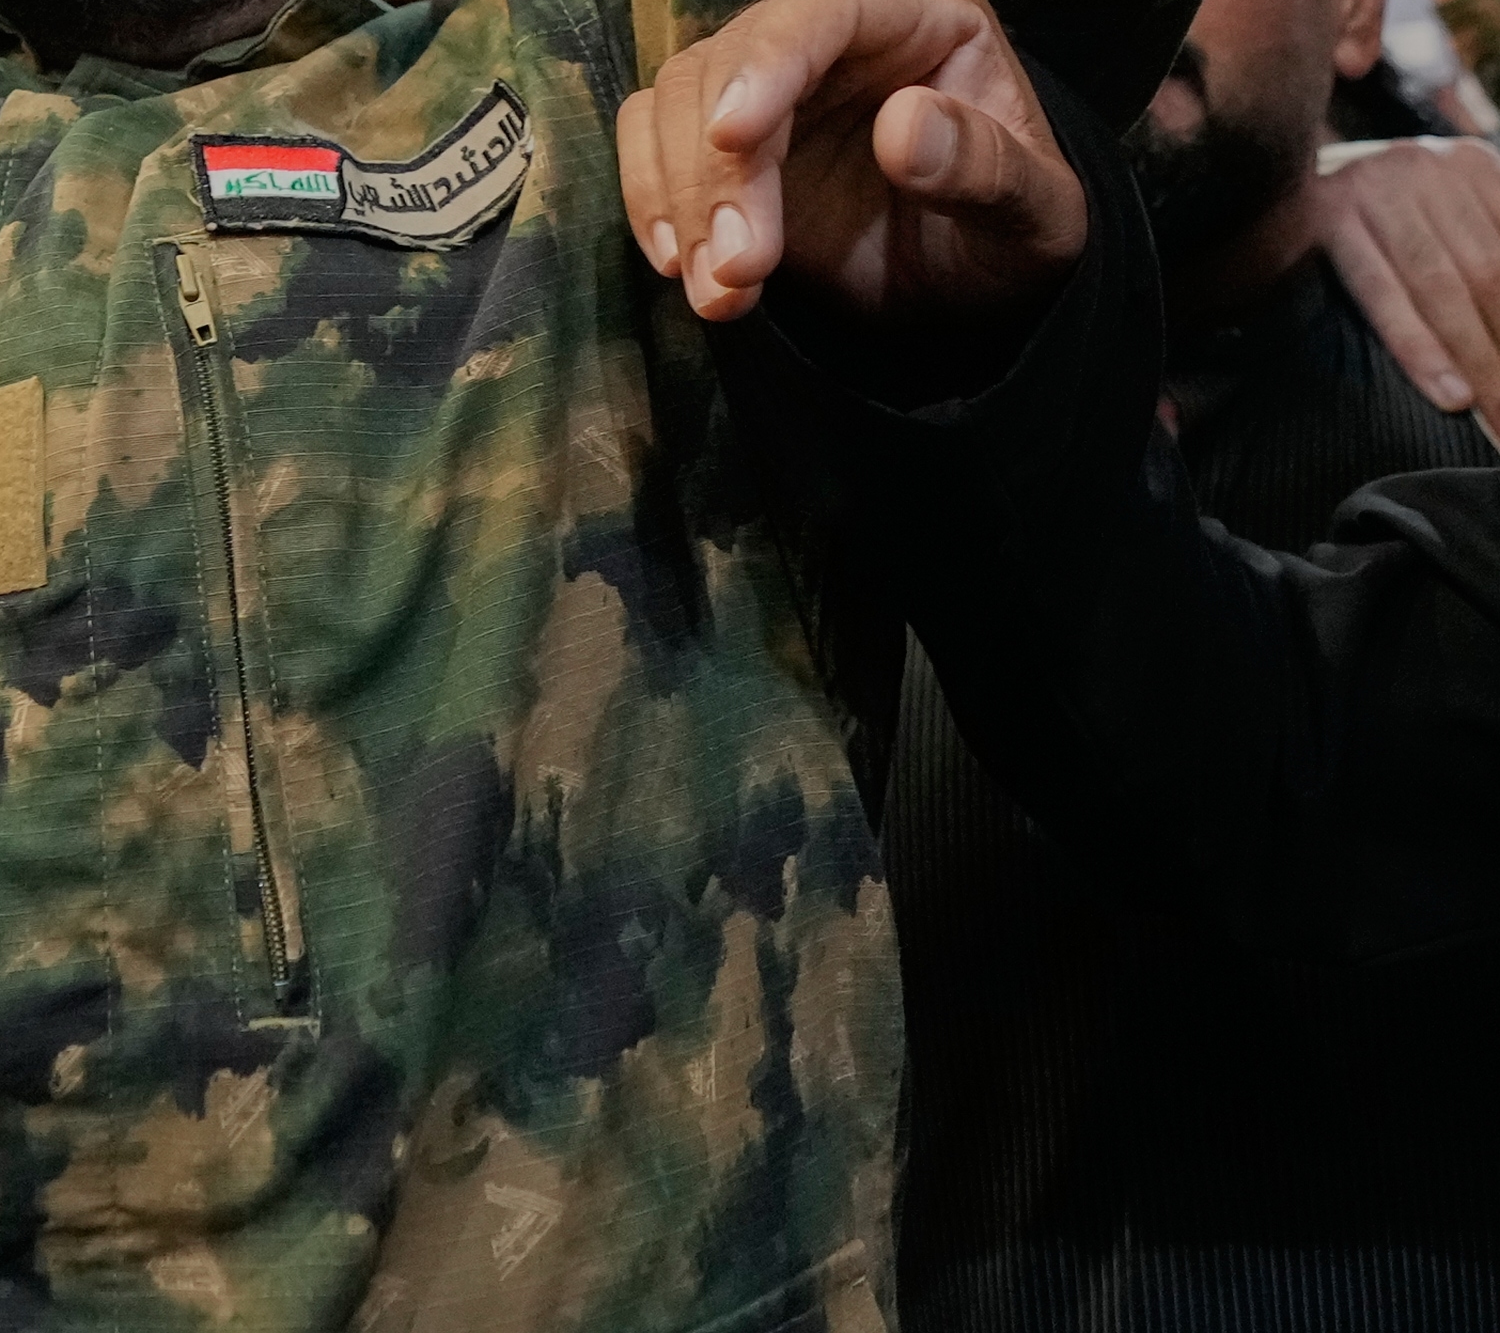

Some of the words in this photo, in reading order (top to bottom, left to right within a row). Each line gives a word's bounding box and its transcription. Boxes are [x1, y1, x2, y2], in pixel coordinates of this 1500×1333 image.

[437, 109, 525, 210] الحشد
[291, 172, 336, 194] الله
[347, 177, 437, 216] الشعبي
